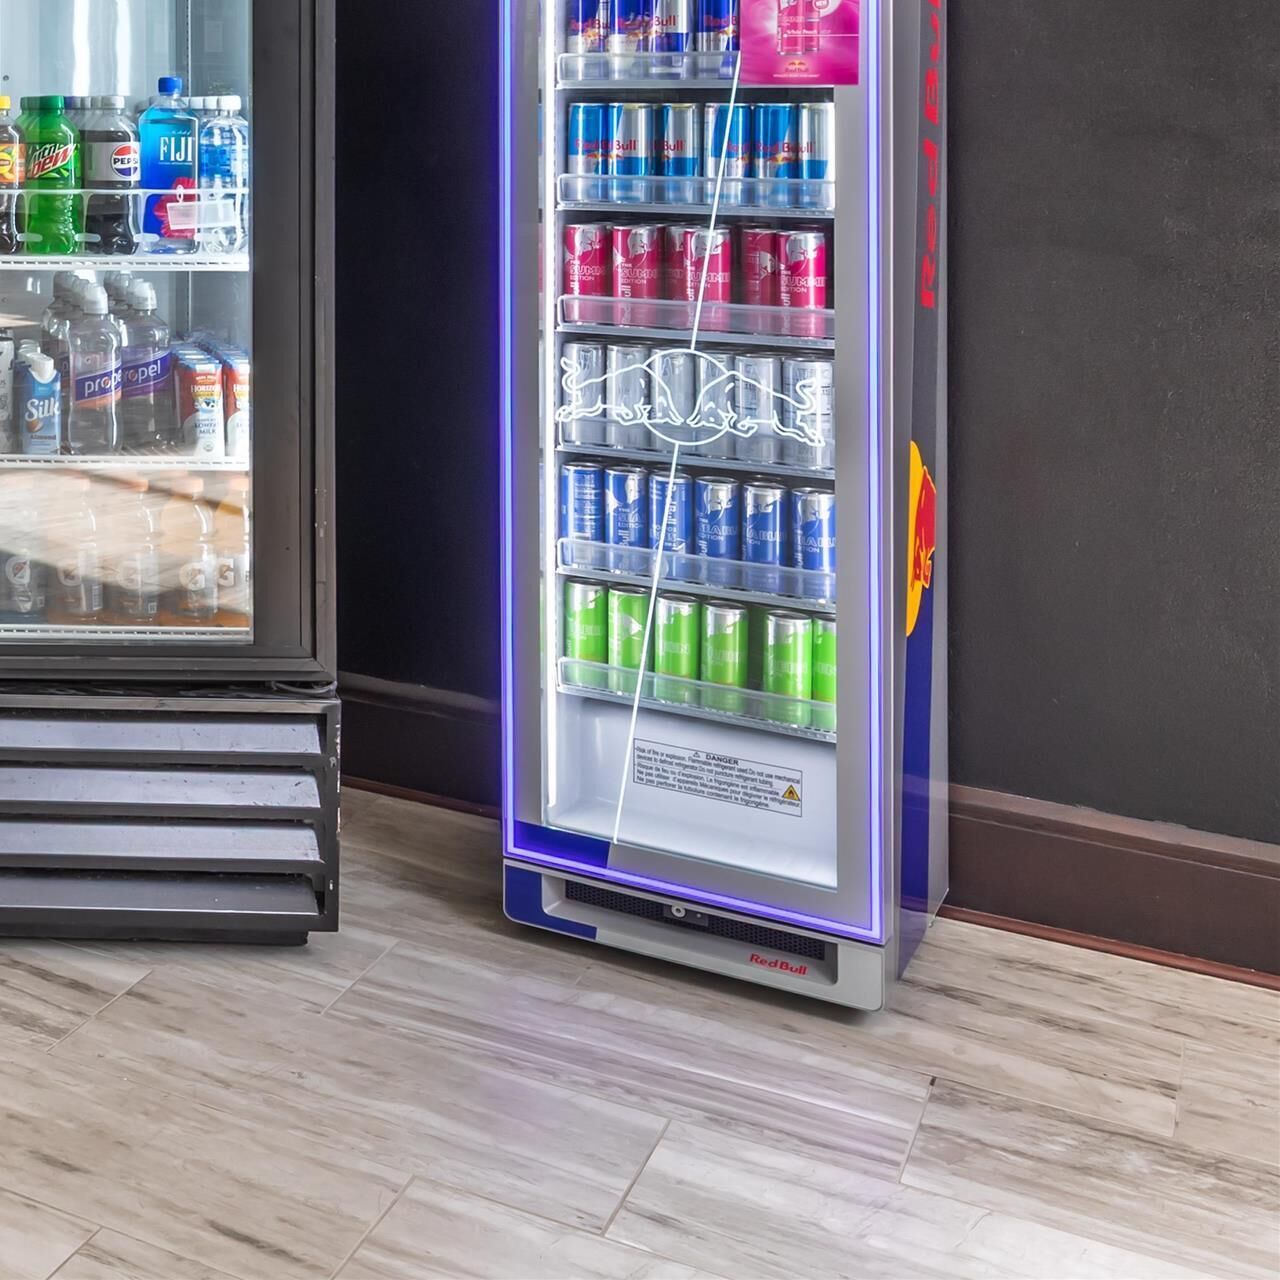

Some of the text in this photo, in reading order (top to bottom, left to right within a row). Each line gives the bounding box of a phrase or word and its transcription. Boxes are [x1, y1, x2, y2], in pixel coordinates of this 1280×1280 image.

[655, 15, 676, 27] Bull
[160, 136, 193, 162] FIJI
[122, 360, 161, 384] ropel
[24, 398, 61, 421] Silk
[705, 754, 738, 765] DANGER
[750, 953, 807, 975] Red Bull
